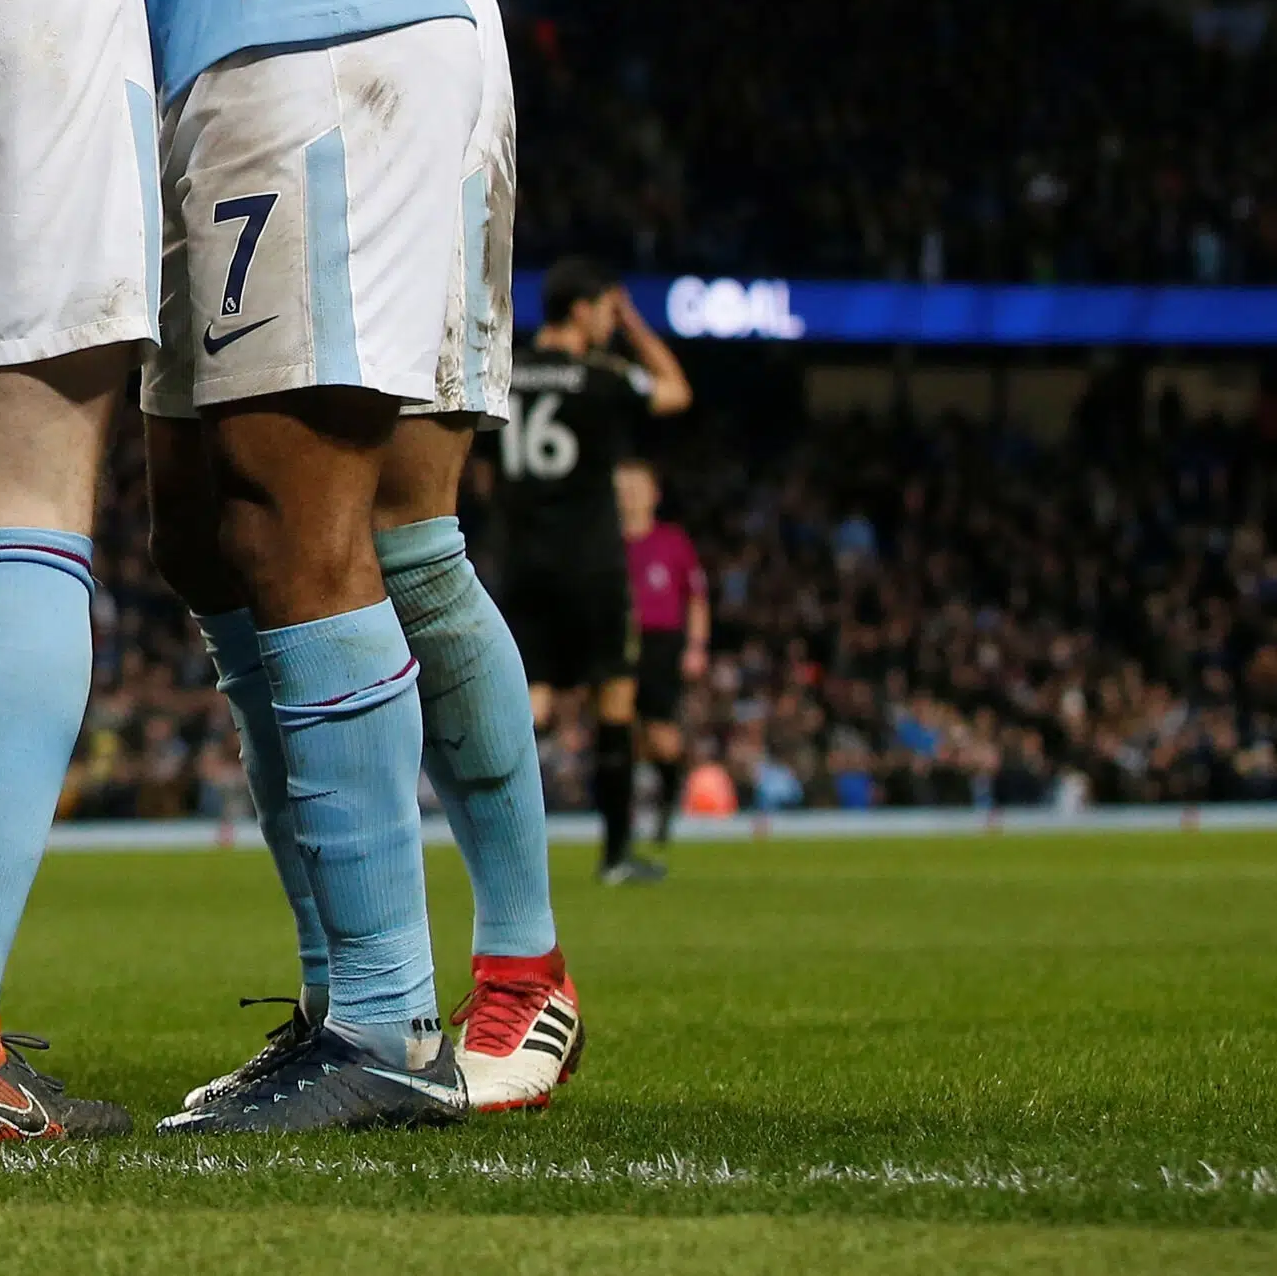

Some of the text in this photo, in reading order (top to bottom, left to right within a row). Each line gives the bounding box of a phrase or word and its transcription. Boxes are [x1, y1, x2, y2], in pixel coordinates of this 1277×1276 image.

[212, 191, 281, 318] 7
[666, 275, 806, 340] GOAL
[501, 391, 579, 480] 16
